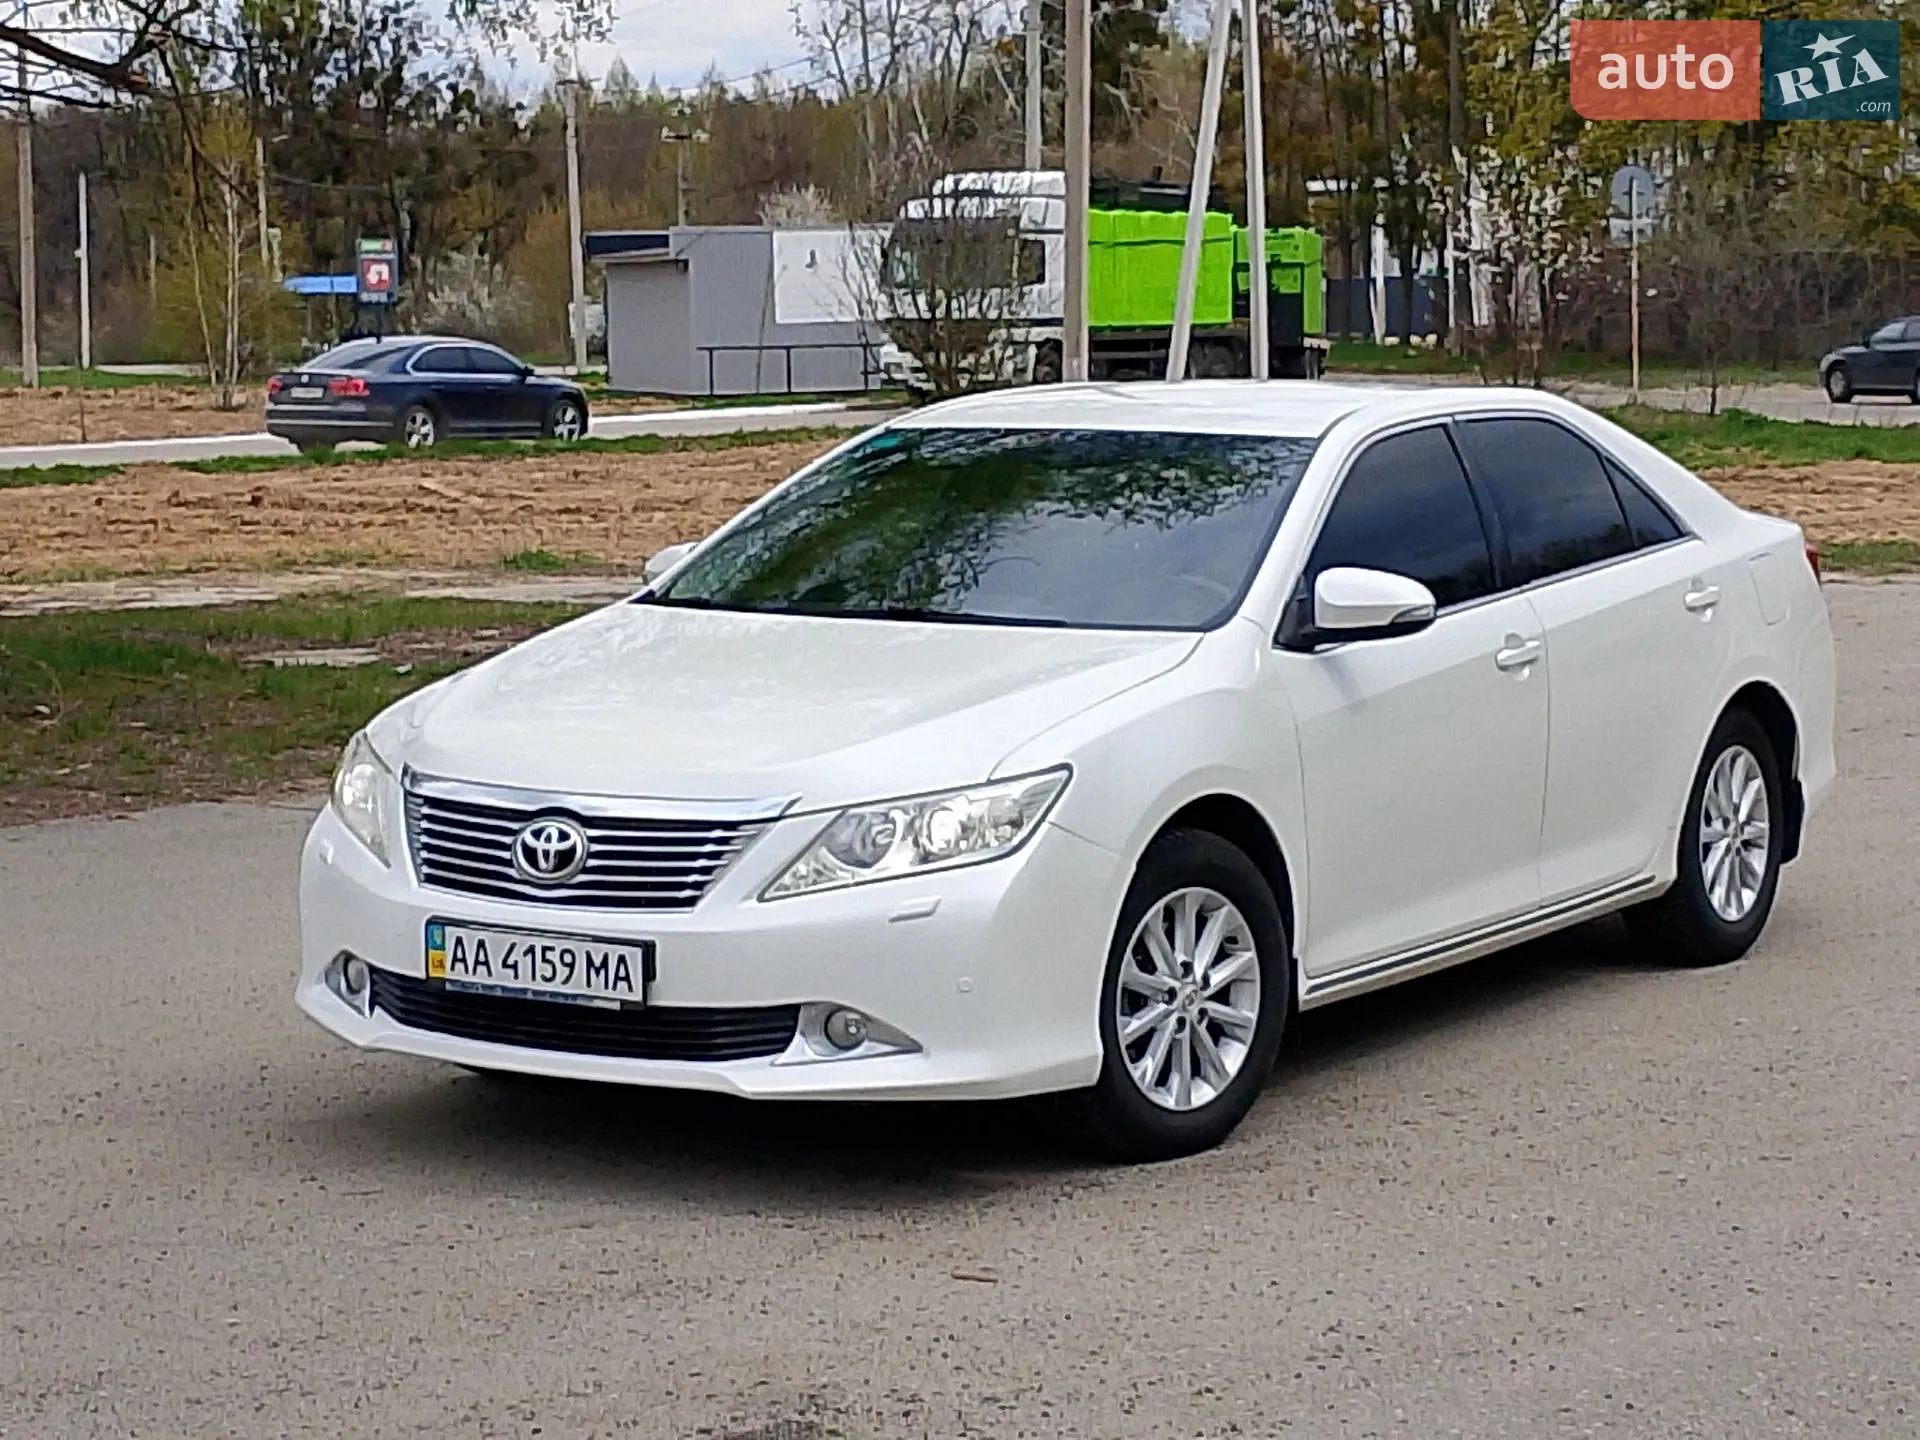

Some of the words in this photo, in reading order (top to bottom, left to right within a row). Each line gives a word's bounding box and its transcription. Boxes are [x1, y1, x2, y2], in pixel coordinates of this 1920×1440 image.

[450, 935, 493, 978] AA
[501, 941, 577, 985] 4159
[584, 949, 634, 993] MA
